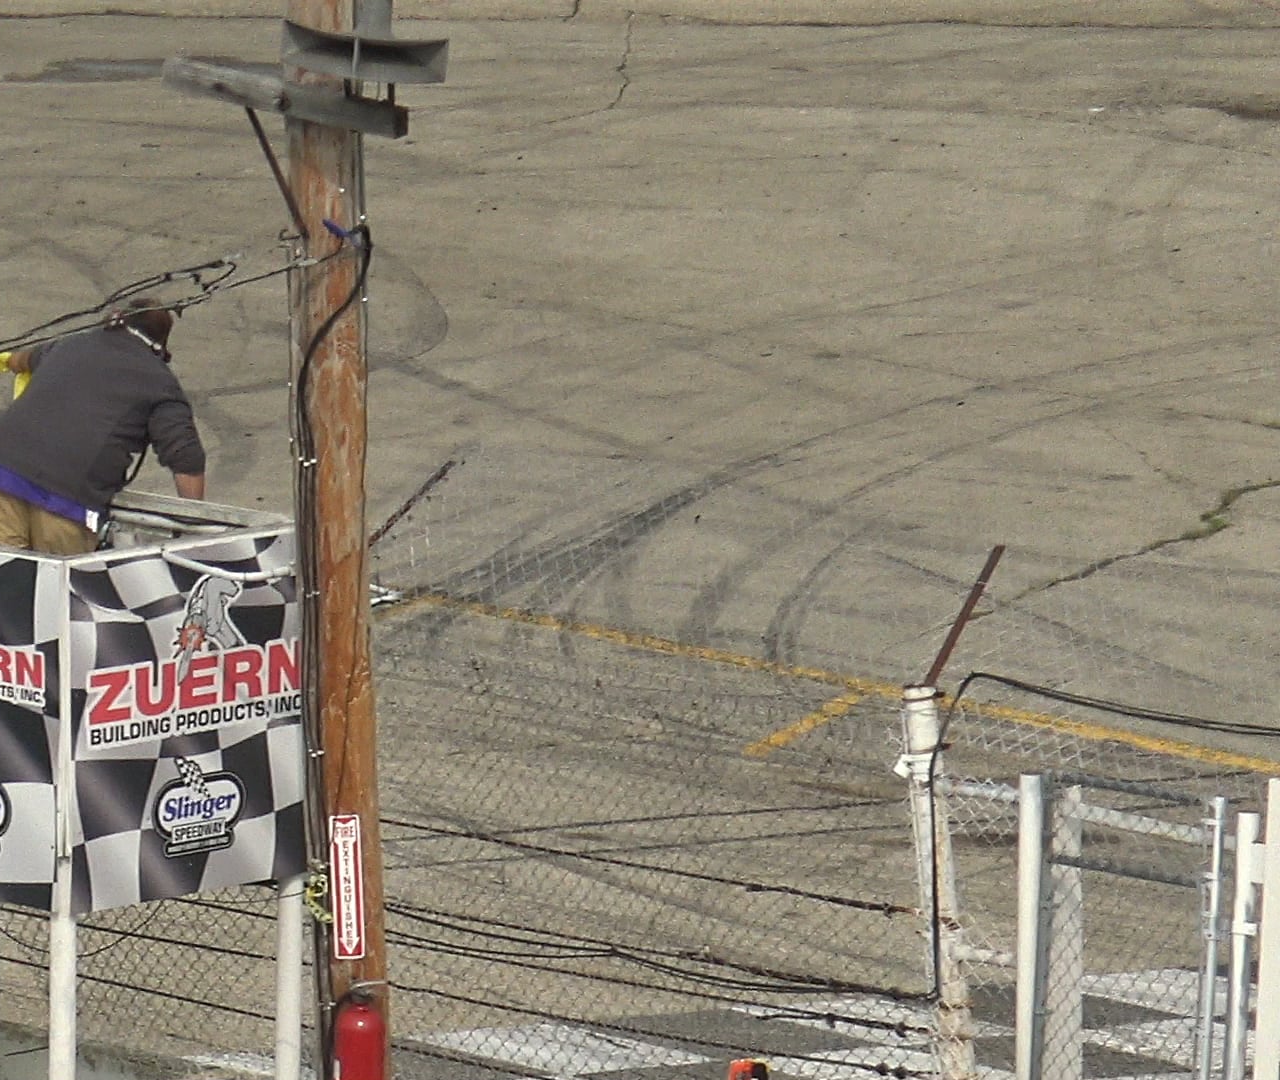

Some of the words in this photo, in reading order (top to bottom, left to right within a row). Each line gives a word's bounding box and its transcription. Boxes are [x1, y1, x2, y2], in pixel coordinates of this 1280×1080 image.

[89, 641, 301, 726] ZUERN
[90, 720, 171, 746] BUILDING
[162, 793, 237, 823] Slinger
[173, 822, 224, 842] SPEEDWAY
